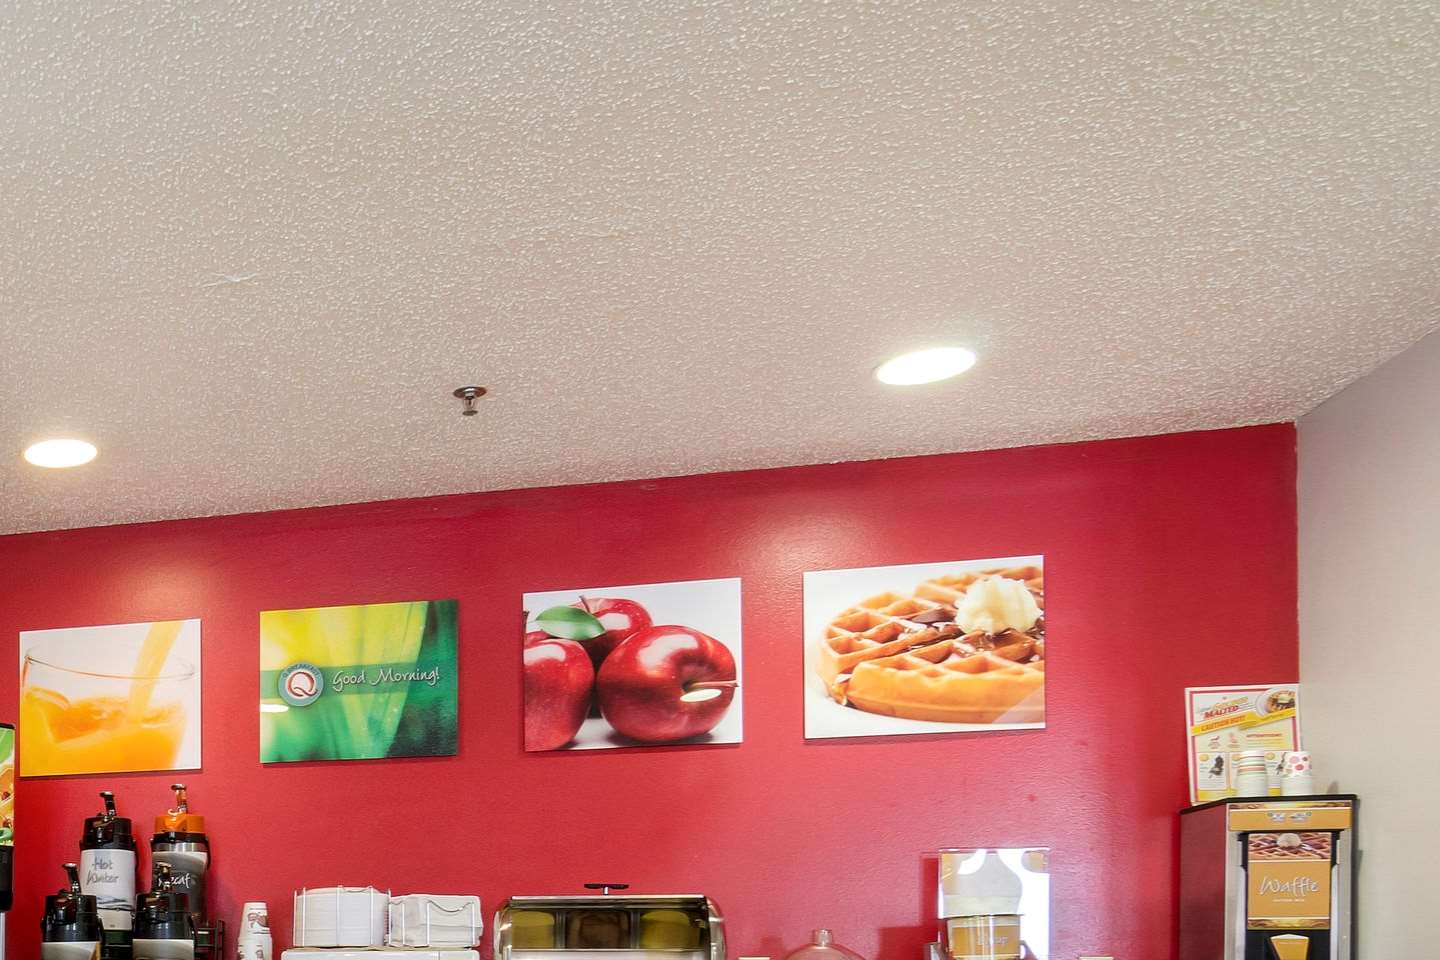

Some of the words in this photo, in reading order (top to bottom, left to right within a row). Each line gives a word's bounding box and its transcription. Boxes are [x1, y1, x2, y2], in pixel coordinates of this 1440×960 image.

[332, 670, 366, 692] Good
[371, 666, 440, 686] Morning!
[92, 856, 113, 870] Hot
[158, 872, 191, 889] caf
[1260, 876, 1320, 897] Waffle
